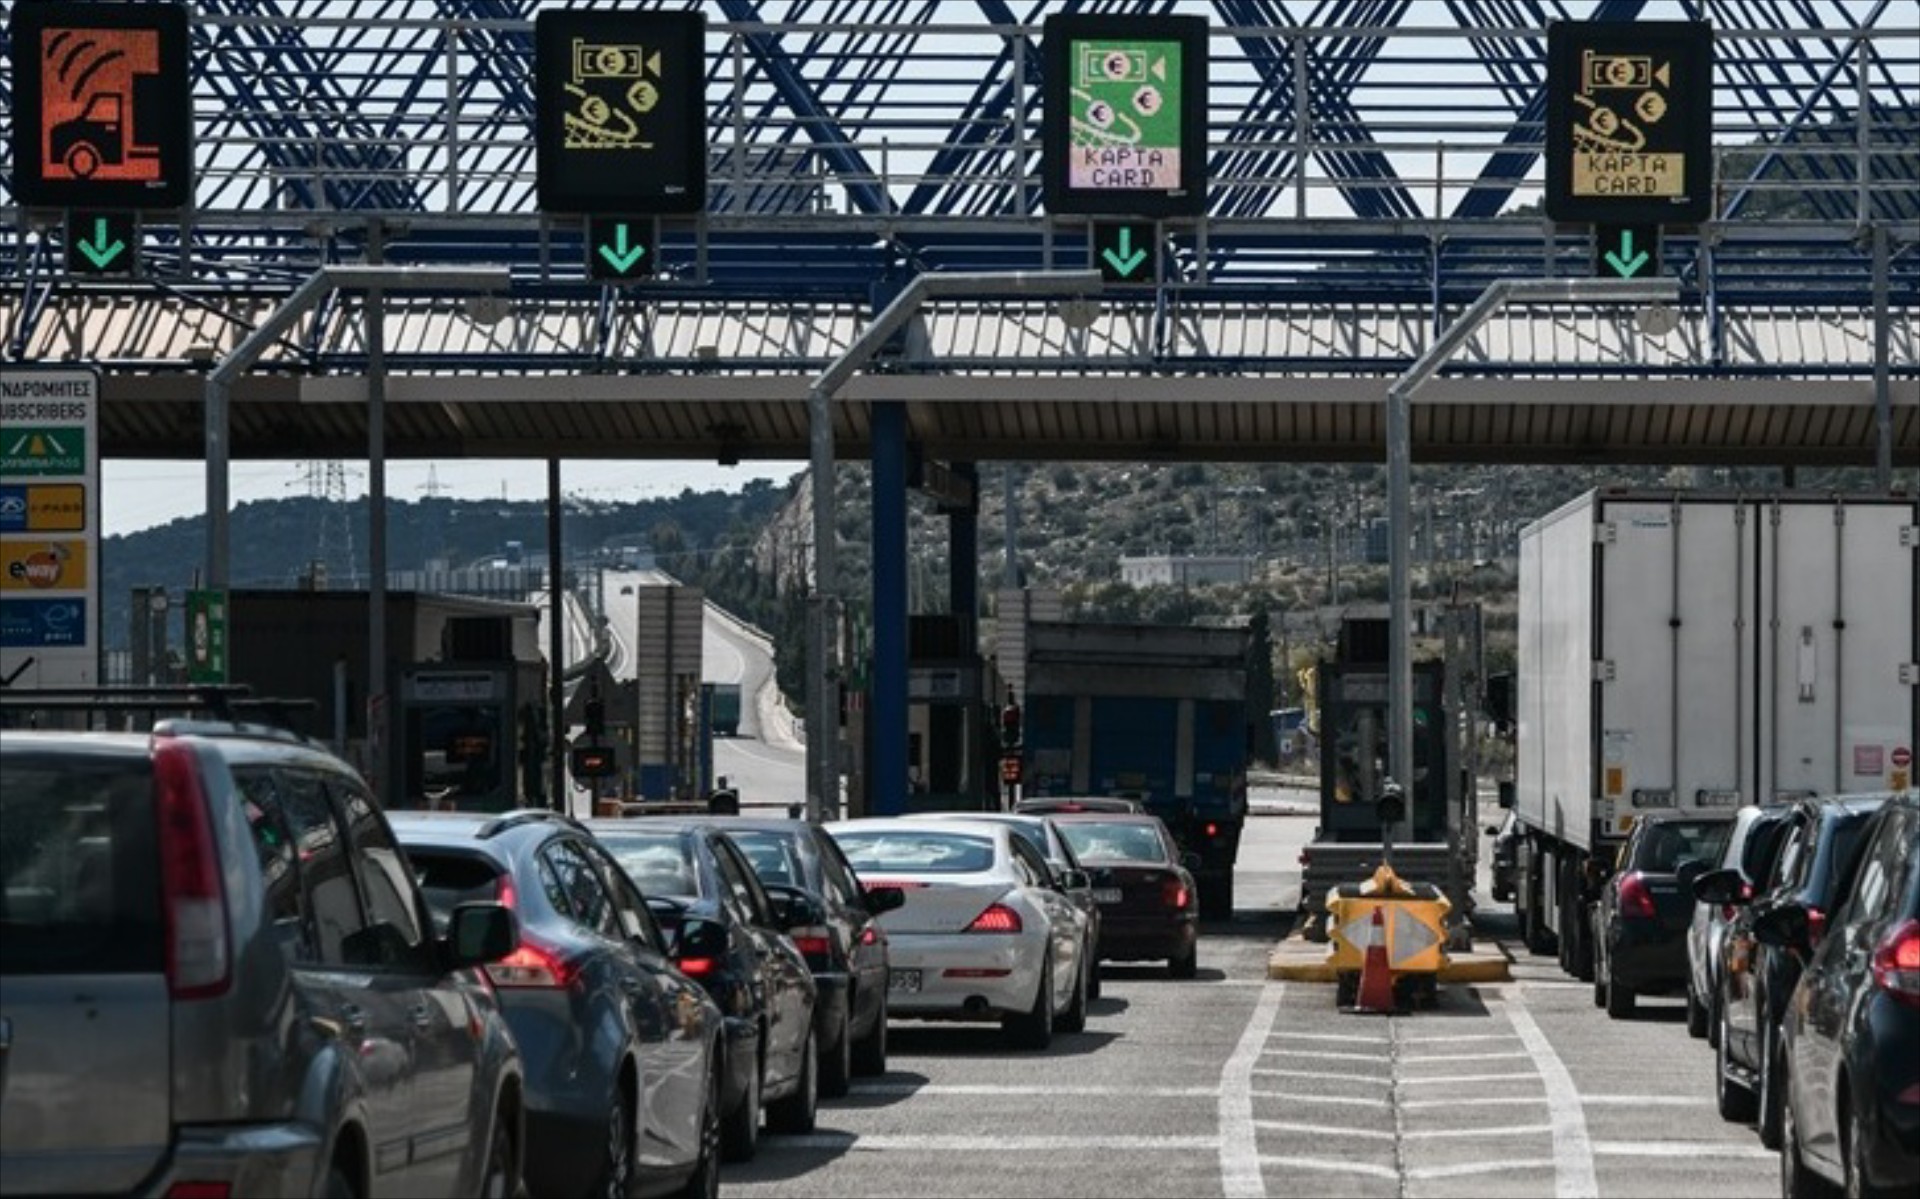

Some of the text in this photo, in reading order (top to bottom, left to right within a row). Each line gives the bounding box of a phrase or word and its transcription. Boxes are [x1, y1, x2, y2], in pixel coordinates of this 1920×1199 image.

[1085, 148, 1163, 166] ΚΑΡΤΑ
[1588, 154, 1667, 172] ΚΑΡΤΑ
[1093, 168, 1155, 187] CARD
[1594, 176, 1657, 193] CARD
